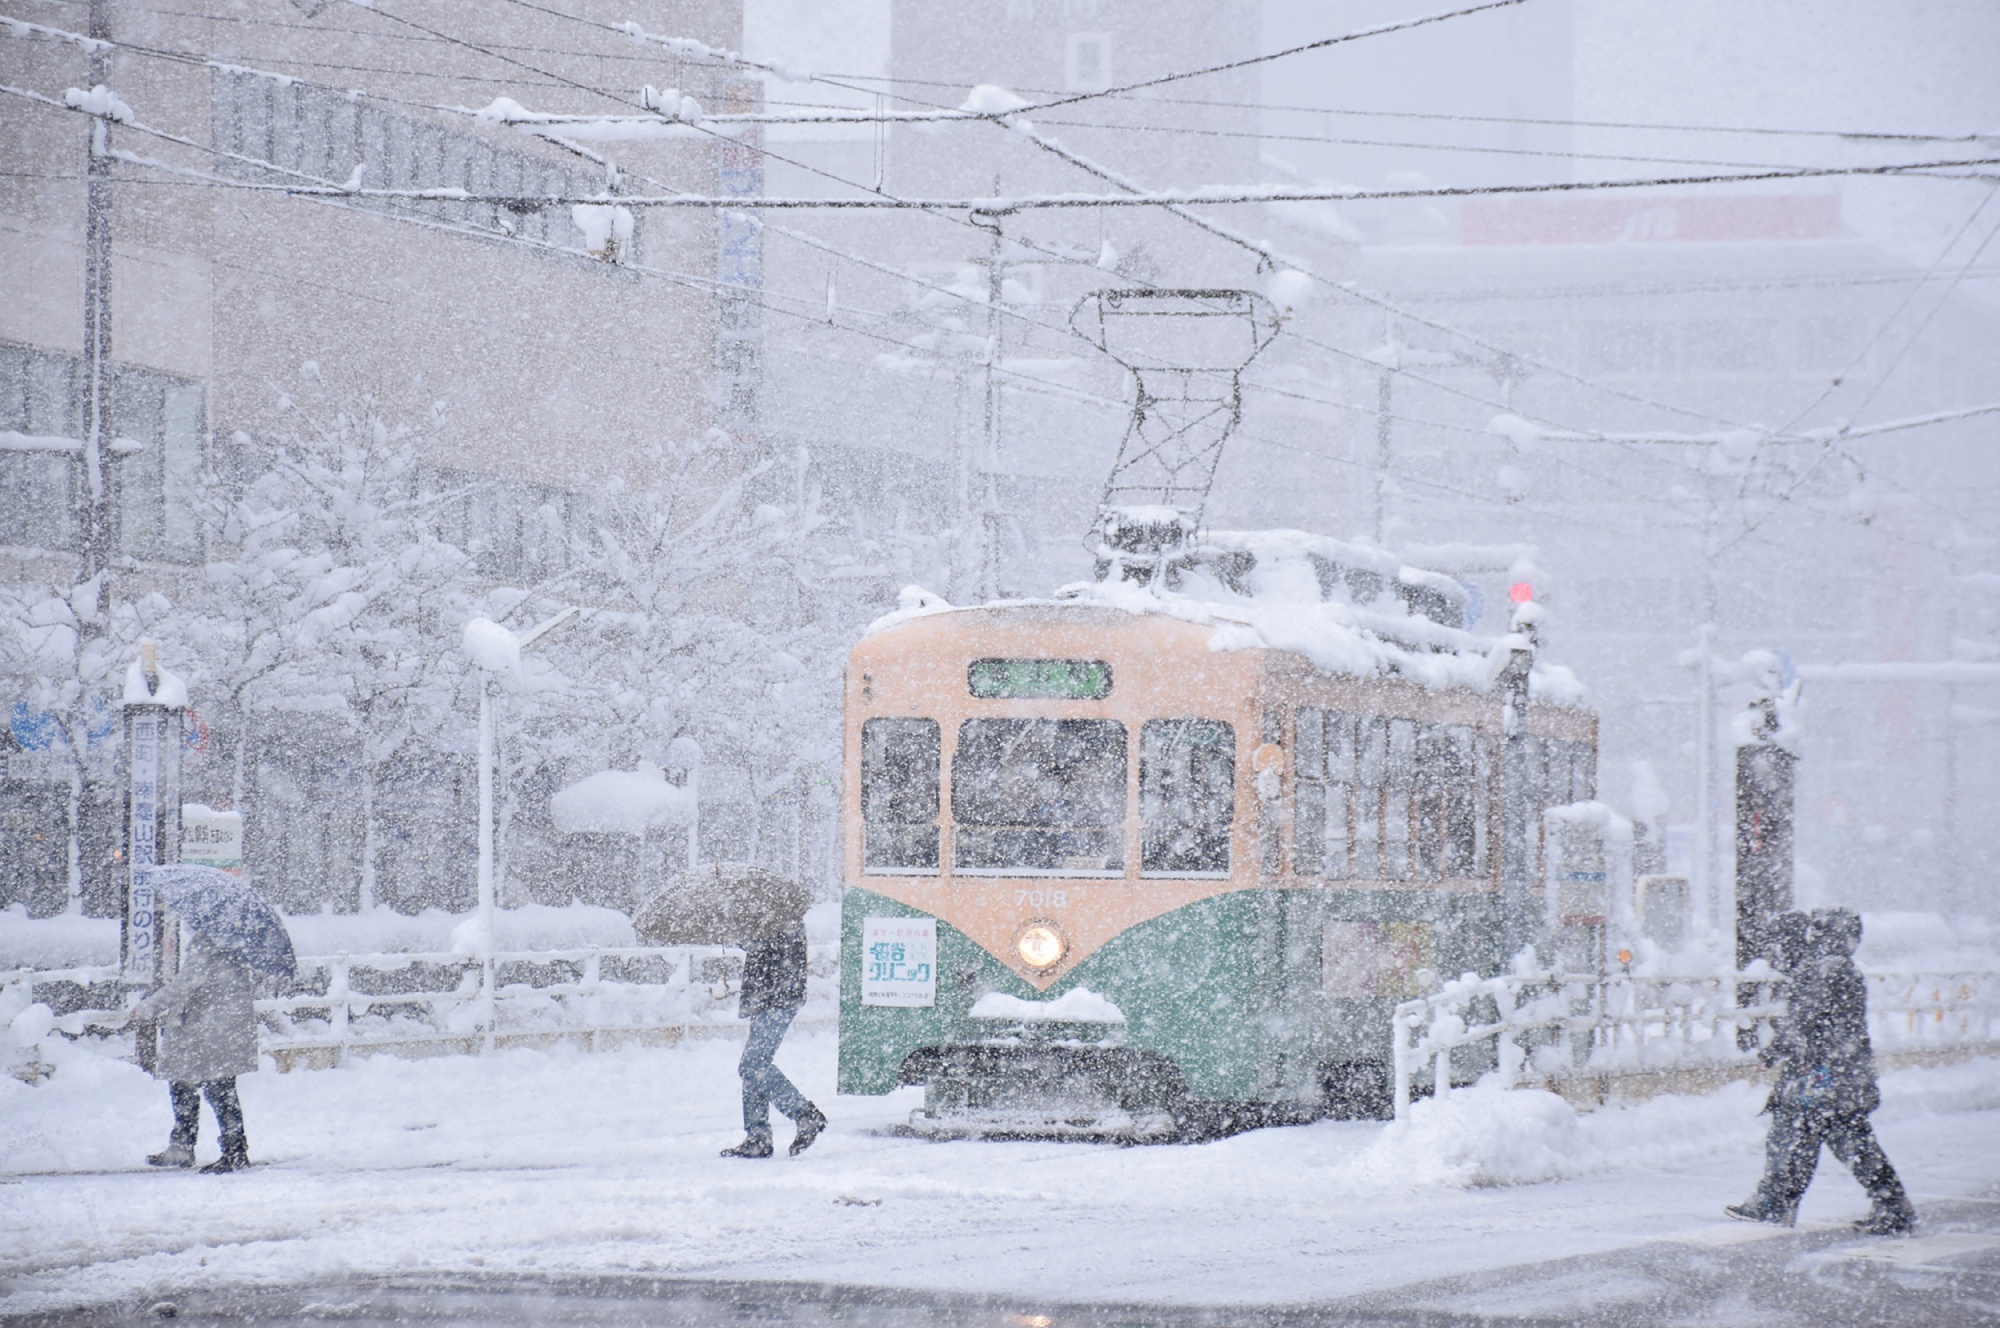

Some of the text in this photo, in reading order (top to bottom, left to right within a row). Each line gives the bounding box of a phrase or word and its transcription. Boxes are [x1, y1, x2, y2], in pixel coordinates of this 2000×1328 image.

[1014, 888, 1067, 909] 7018
[868, 962, 931, 982] クリニック
